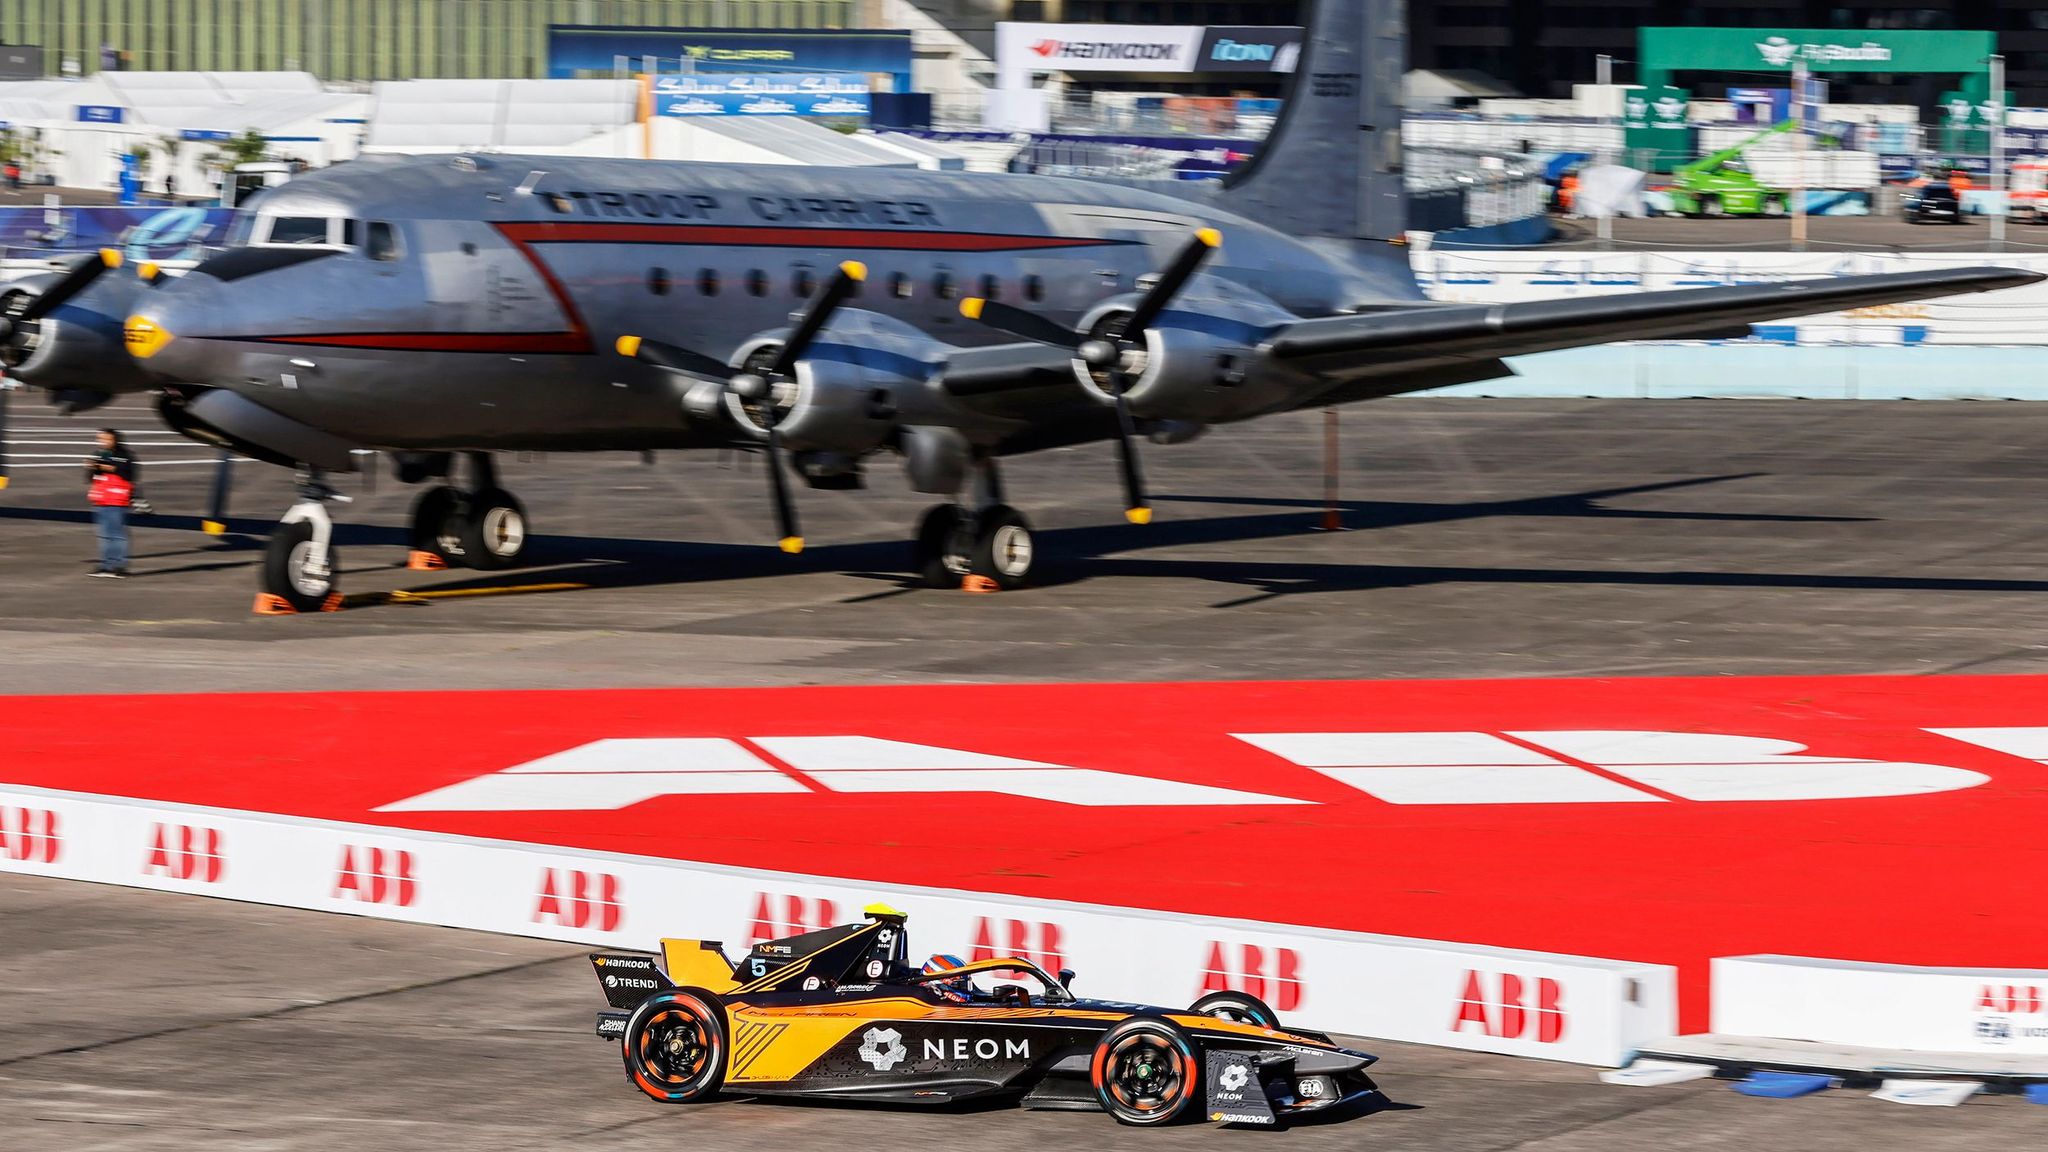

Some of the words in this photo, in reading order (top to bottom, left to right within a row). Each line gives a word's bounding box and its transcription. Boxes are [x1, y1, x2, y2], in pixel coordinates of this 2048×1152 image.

[565, 191, 722, 220] TROOP
[746, 196, 943, 226] CARRIER
[142, 822, 227, 883] ABB
[330, 845, 420, 907] ABB
[530, 867, 624, 932] ABB
[751, 958, 766, 977] 5
[869, 961, 881, 977] E
[1198, 940, 1310, 1012] ABB
[1449, 969, 1567, 1043] ABB
[1974, 984, 2043, 1013] ABB
[923, 1038, 1030, 1060] NEOM
[1216, 1092, 1243, 1101] NEOM
[1300, 1081, 1323, 1096] FIA
